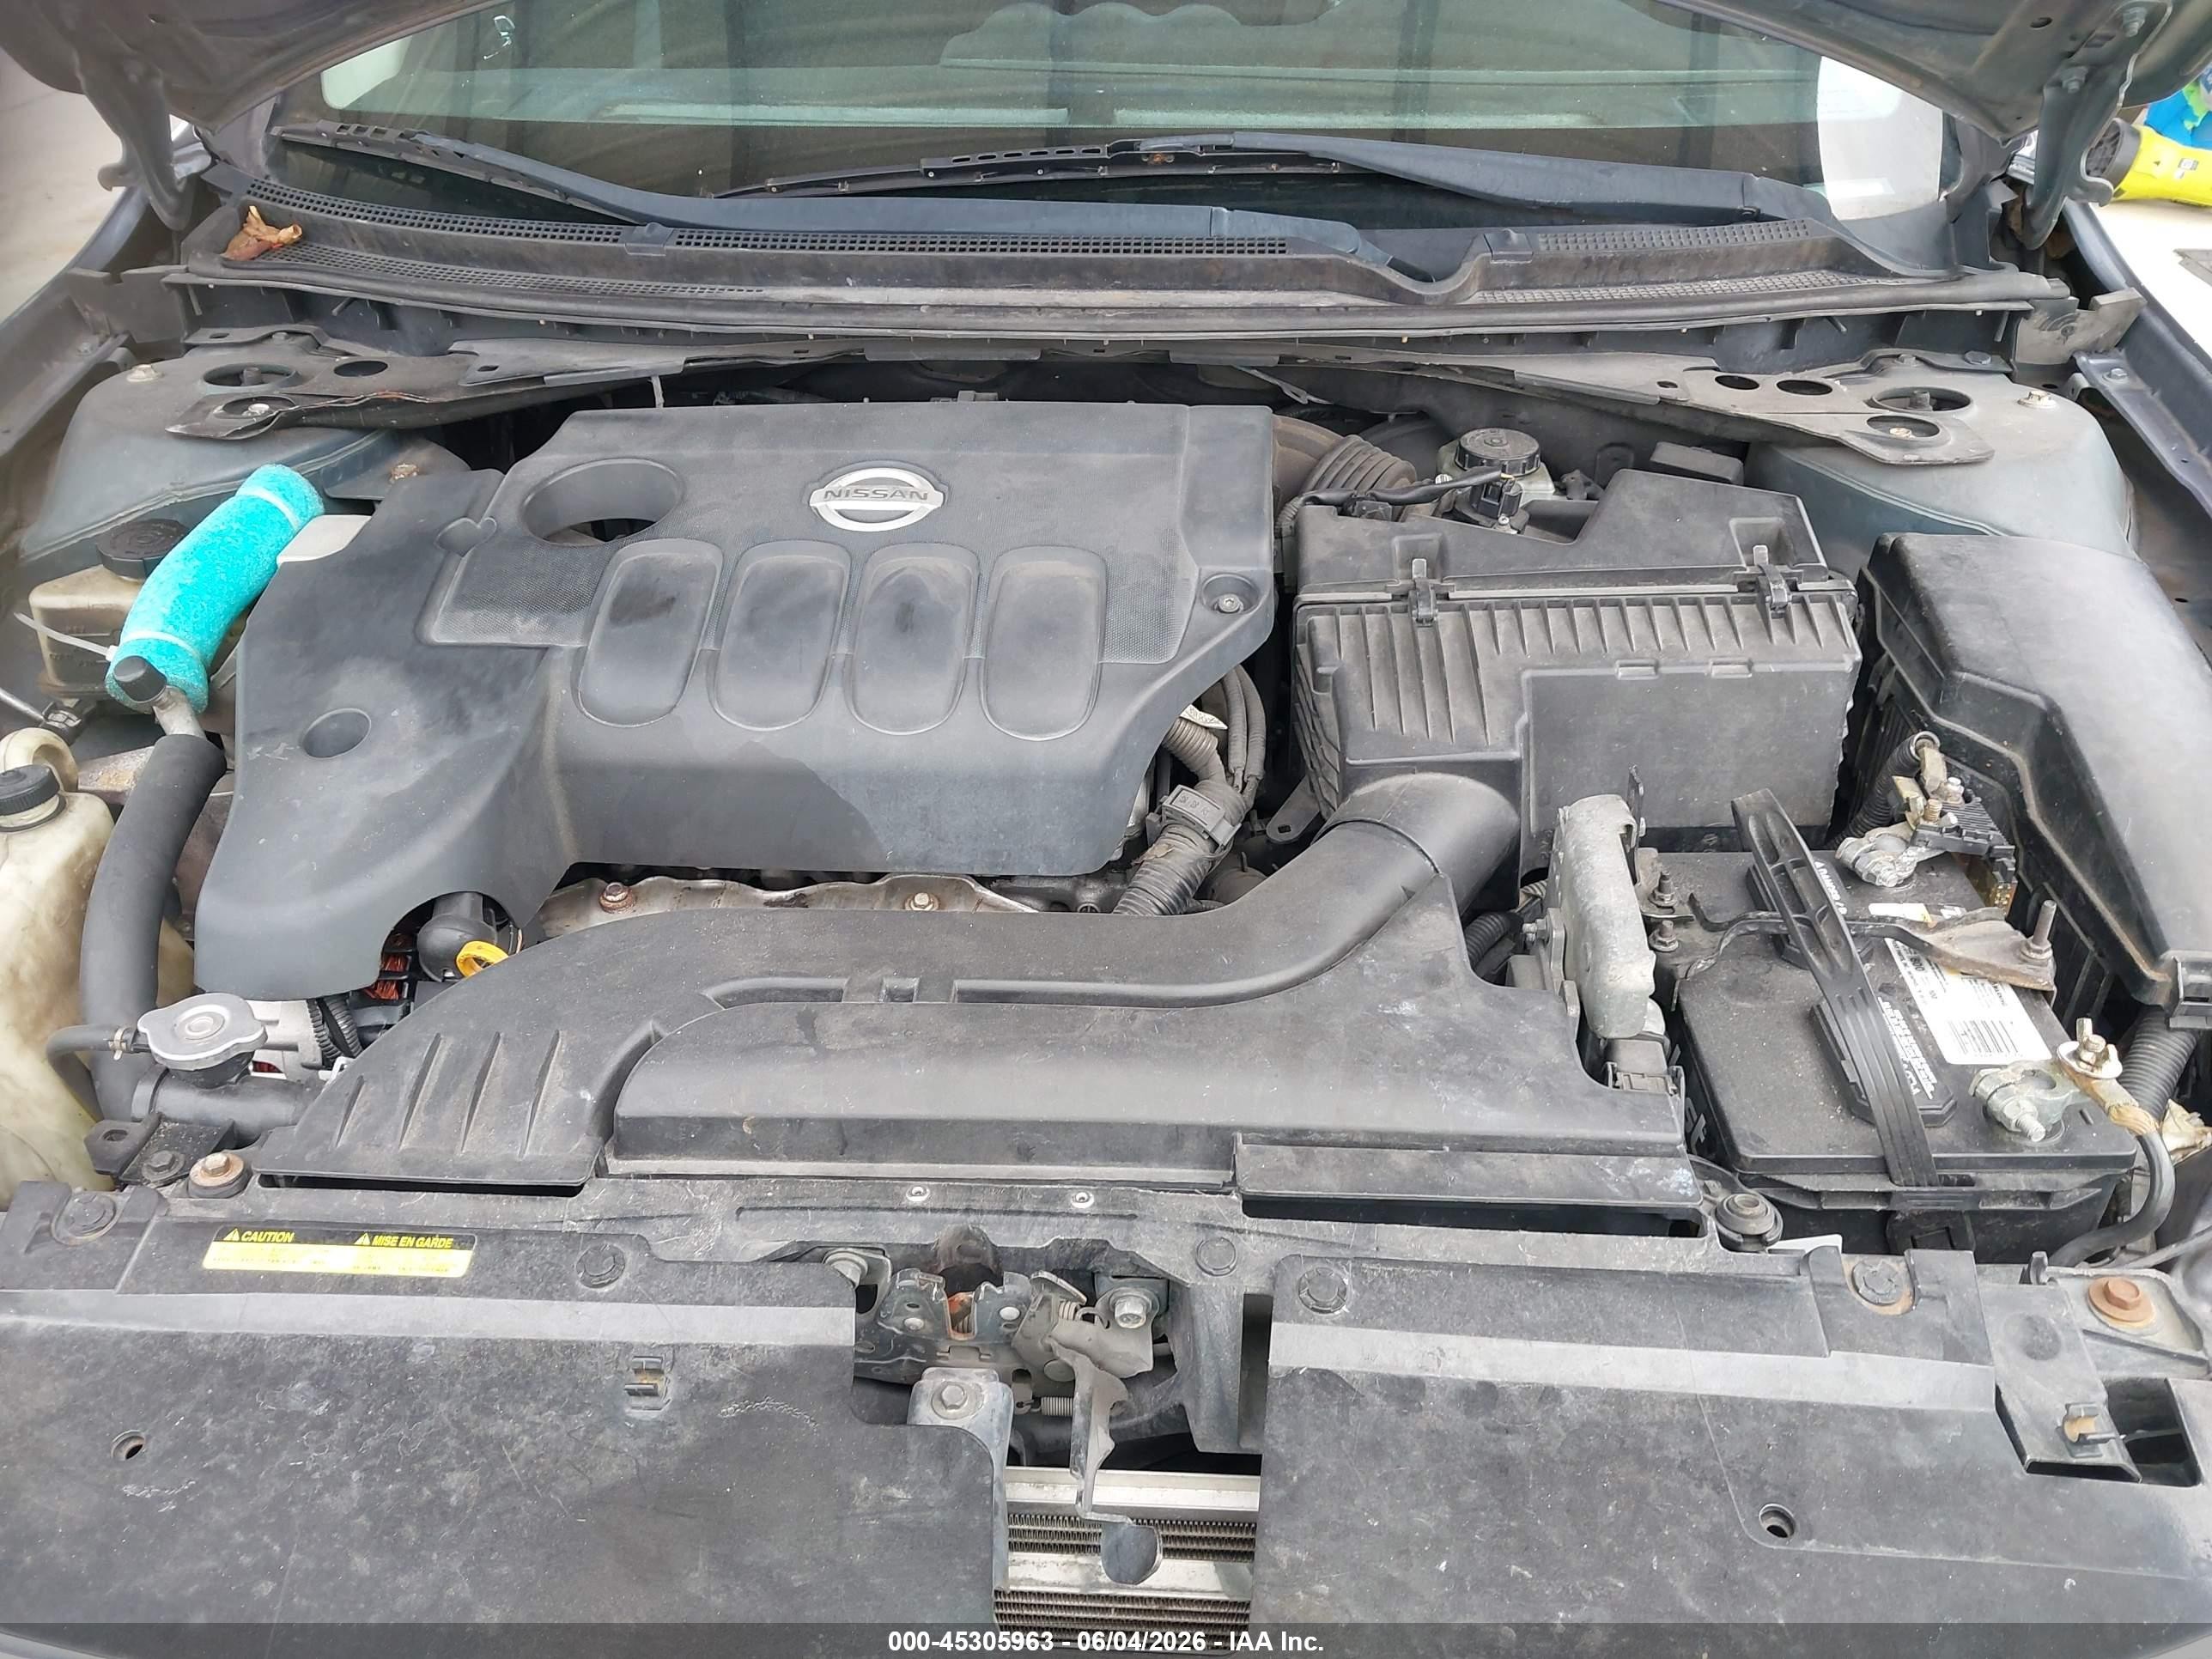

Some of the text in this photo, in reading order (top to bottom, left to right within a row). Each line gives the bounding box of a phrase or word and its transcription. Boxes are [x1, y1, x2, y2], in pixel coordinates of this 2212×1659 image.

[823, 489, 928, 501] NISSAN
[241, 1231, 295, 1243] CAUTION
[371, 1235, 453, 1249] MISE EN GARDE
